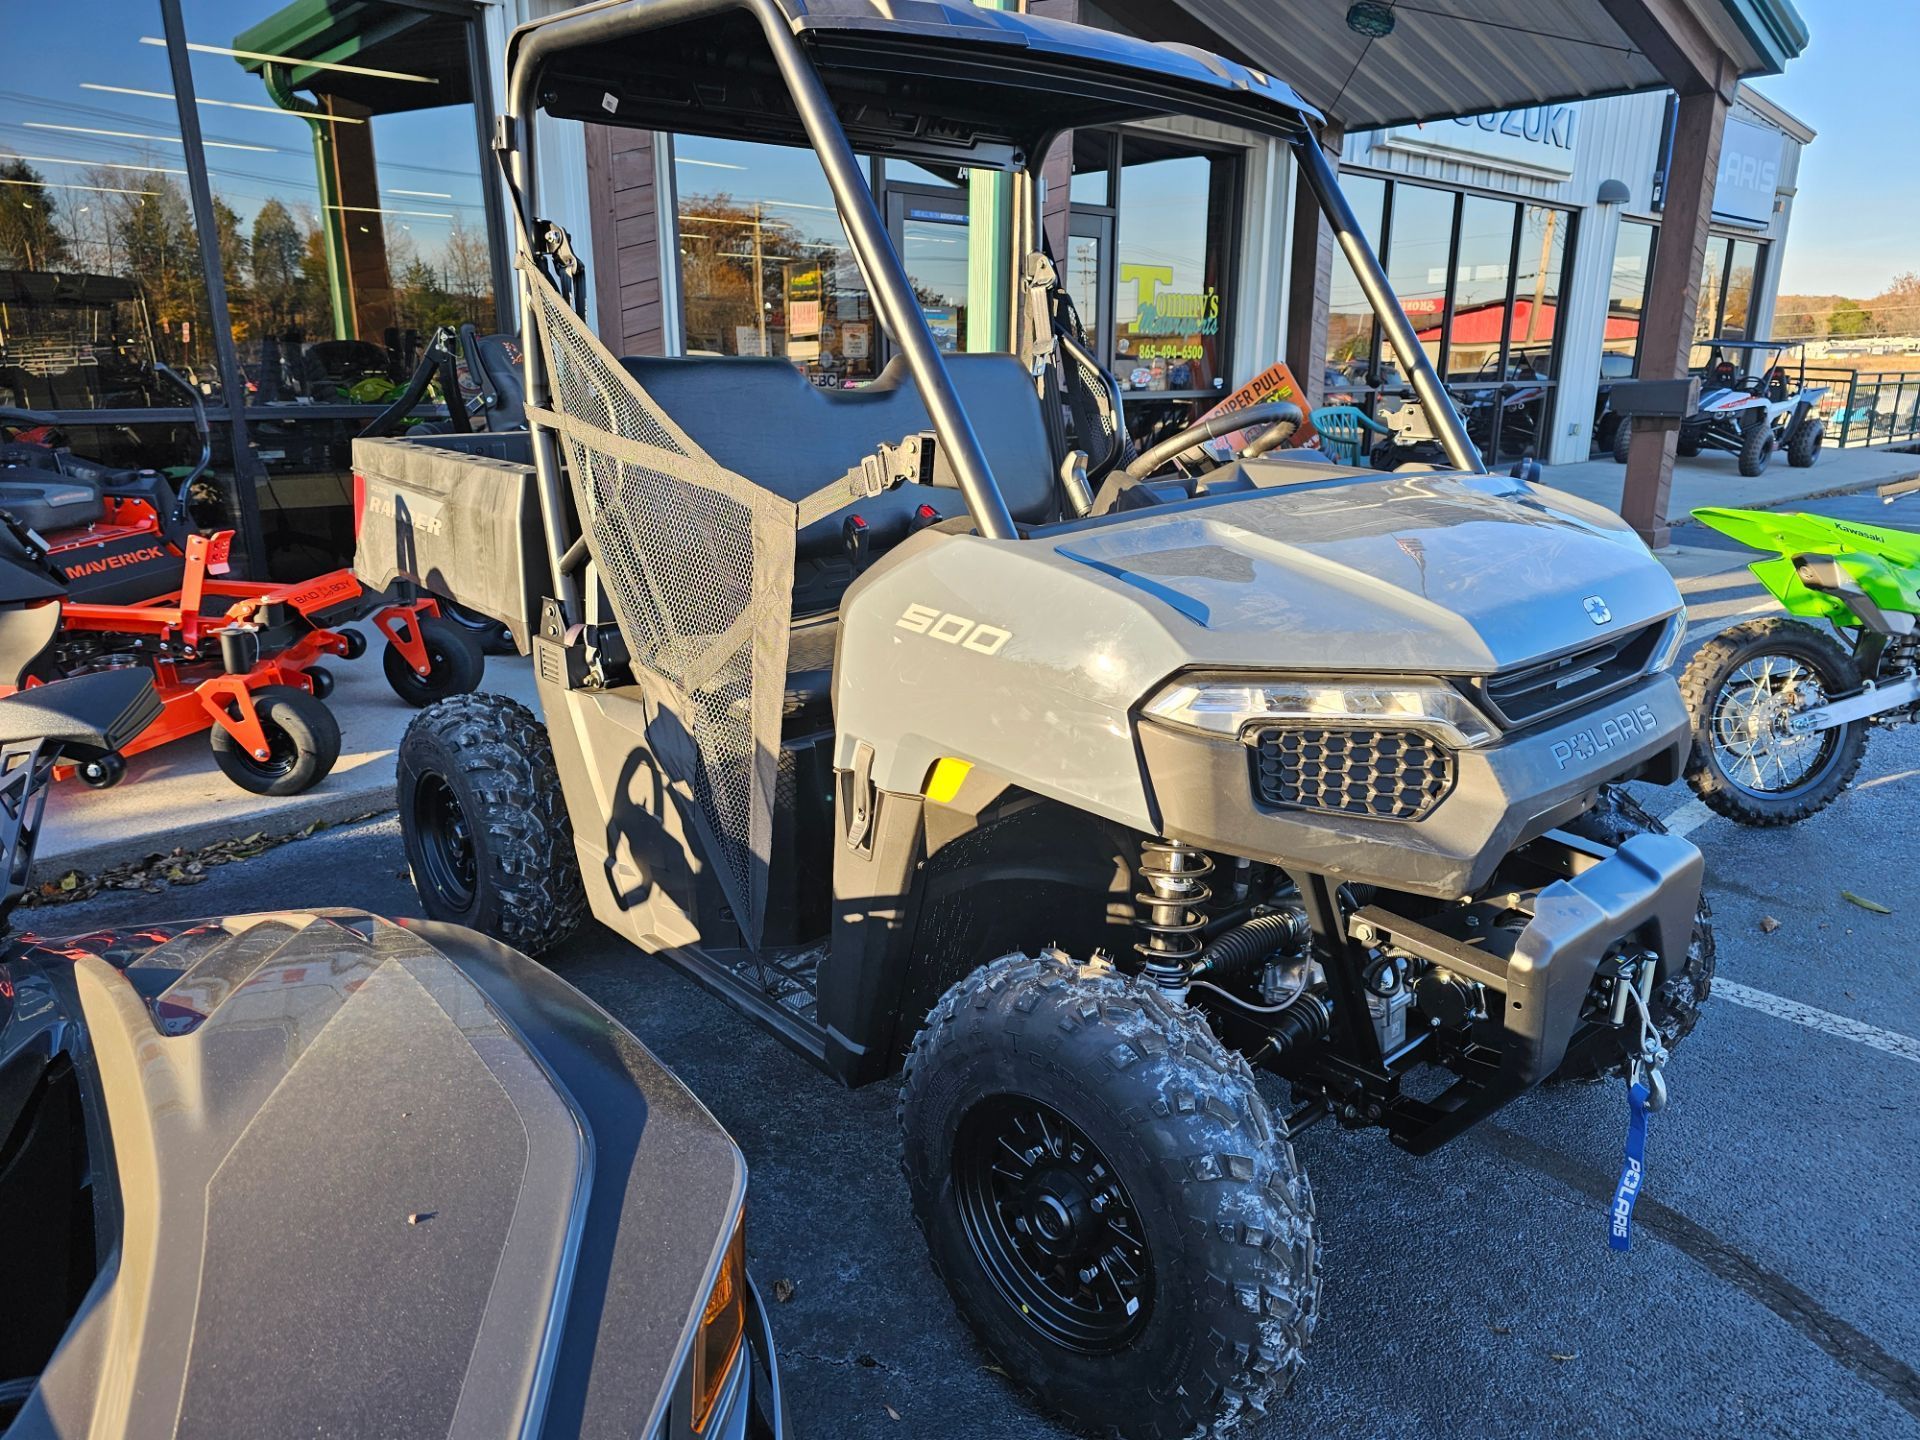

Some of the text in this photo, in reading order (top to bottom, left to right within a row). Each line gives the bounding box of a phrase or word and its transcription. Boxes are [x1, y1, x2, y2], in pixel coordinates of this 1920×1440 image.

[1453, 105, 1577, 150] UZUKI
[1120, 263, 1219, 334] Tommy's
[1139, 344, 1204, 360] 865-494-6500
[1251, 368, 1286, 397] PULL
[1834, 522, 1885, 544] Kawasaki
[64, 545, 165, 580] MAVERICK
[294, 580, 351, 604] BAD BOY
[895, 602, 1013, 656] 500
[1550, 703, 1658, 771] POLARIS
[1613, 1156, 1642, 1238] POLARIS
